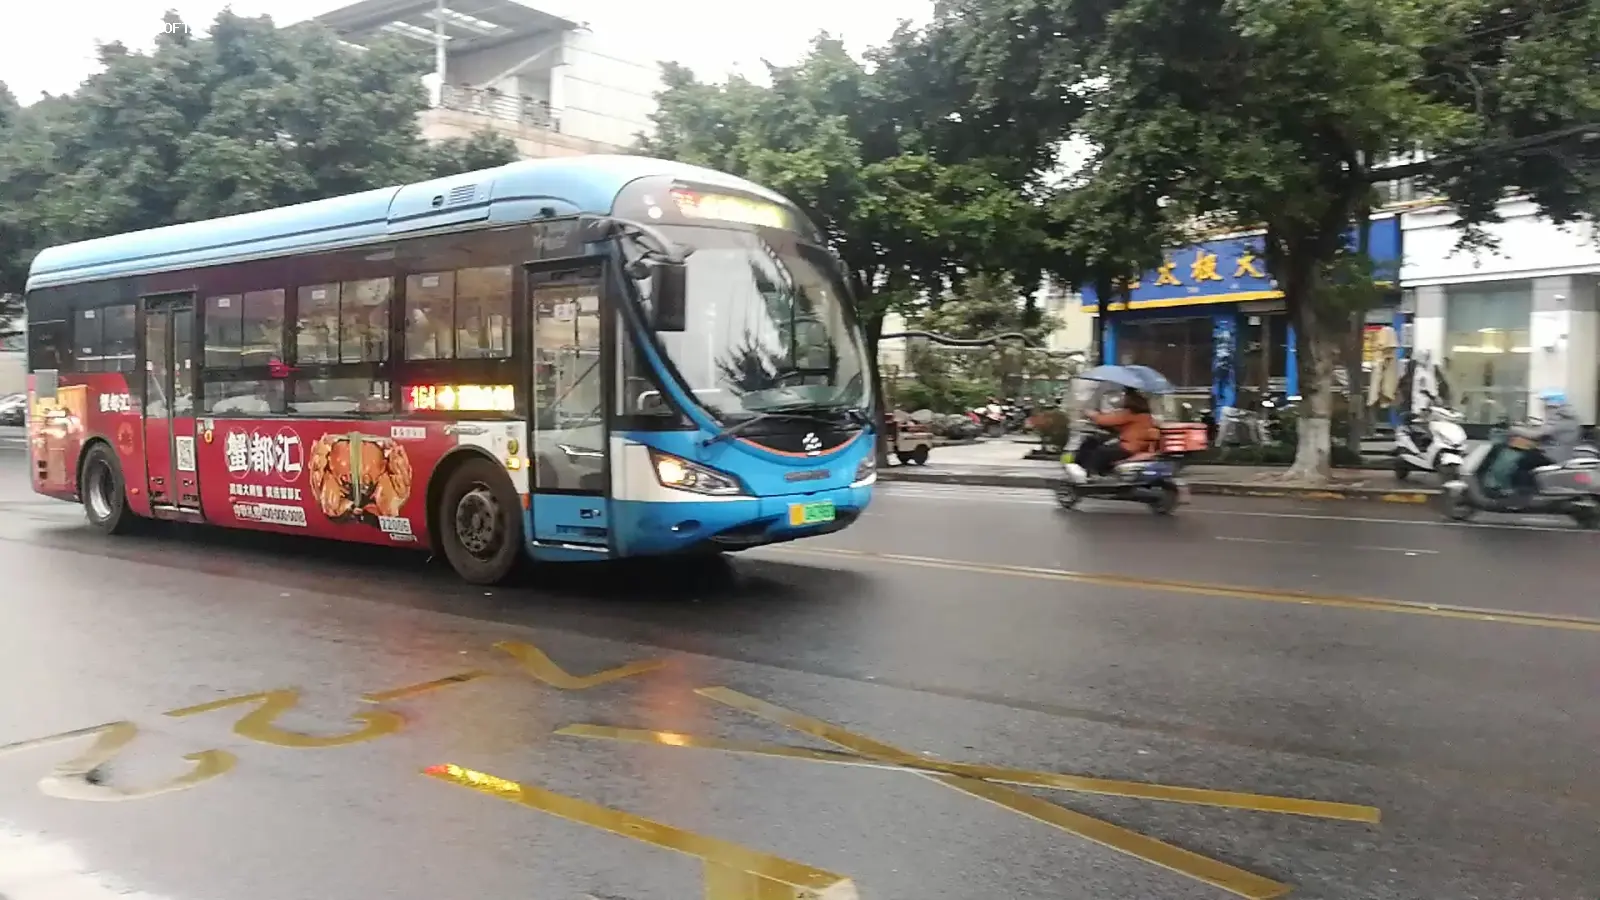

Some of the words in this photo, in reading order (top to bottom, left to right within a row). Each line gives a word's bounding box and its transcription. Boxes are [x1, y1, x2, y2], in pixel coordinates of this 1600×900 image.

[411, 385, 435, 410] 164
[226, 431, 302, 476] 蟹都汇
